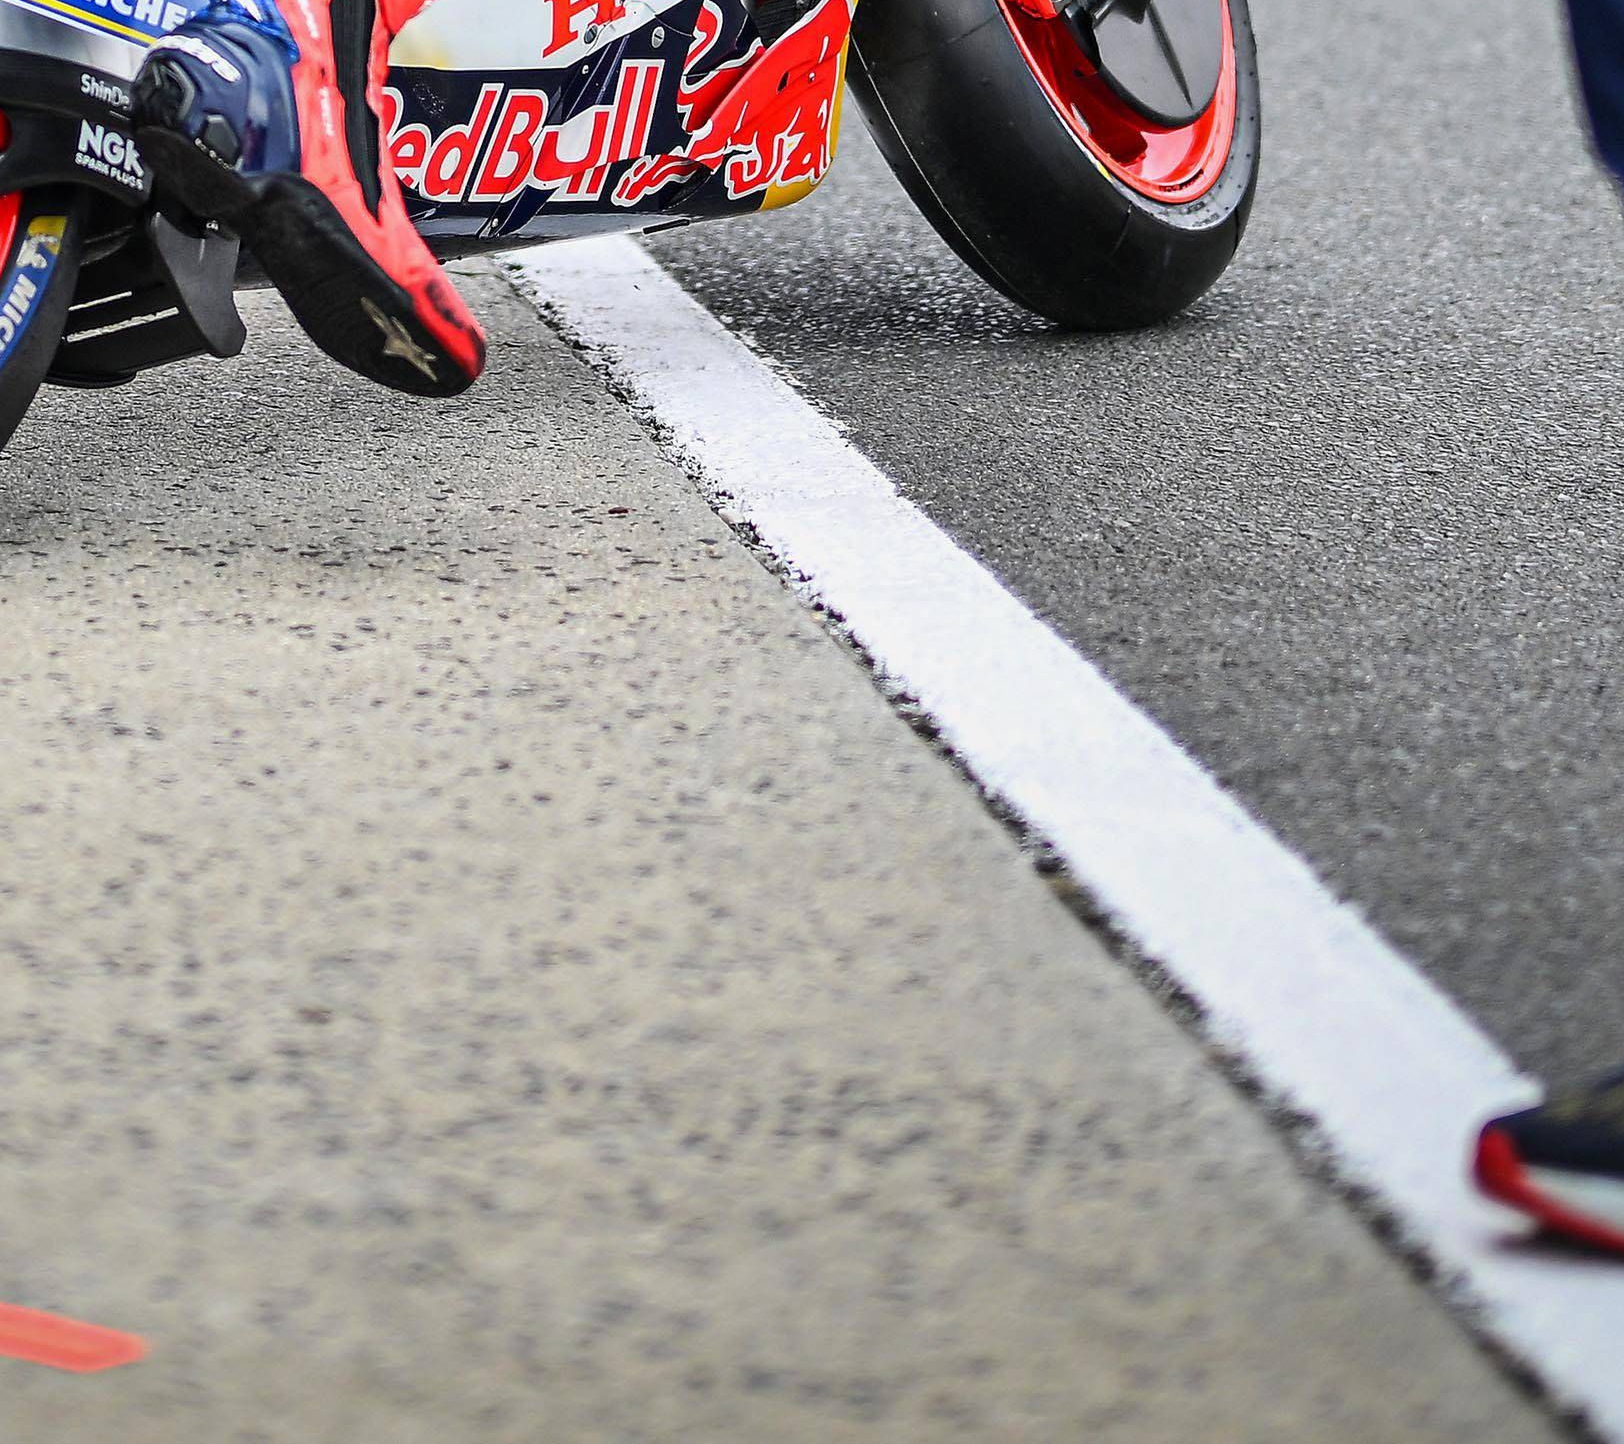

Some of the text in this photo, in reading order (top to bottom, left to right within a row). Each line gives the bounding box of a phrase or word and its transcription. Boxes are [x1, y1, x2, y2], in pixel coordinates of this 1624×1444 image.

[75, 152, 144, 191] SPARK PLUGS
[78, 118, 145, 178] NGK
